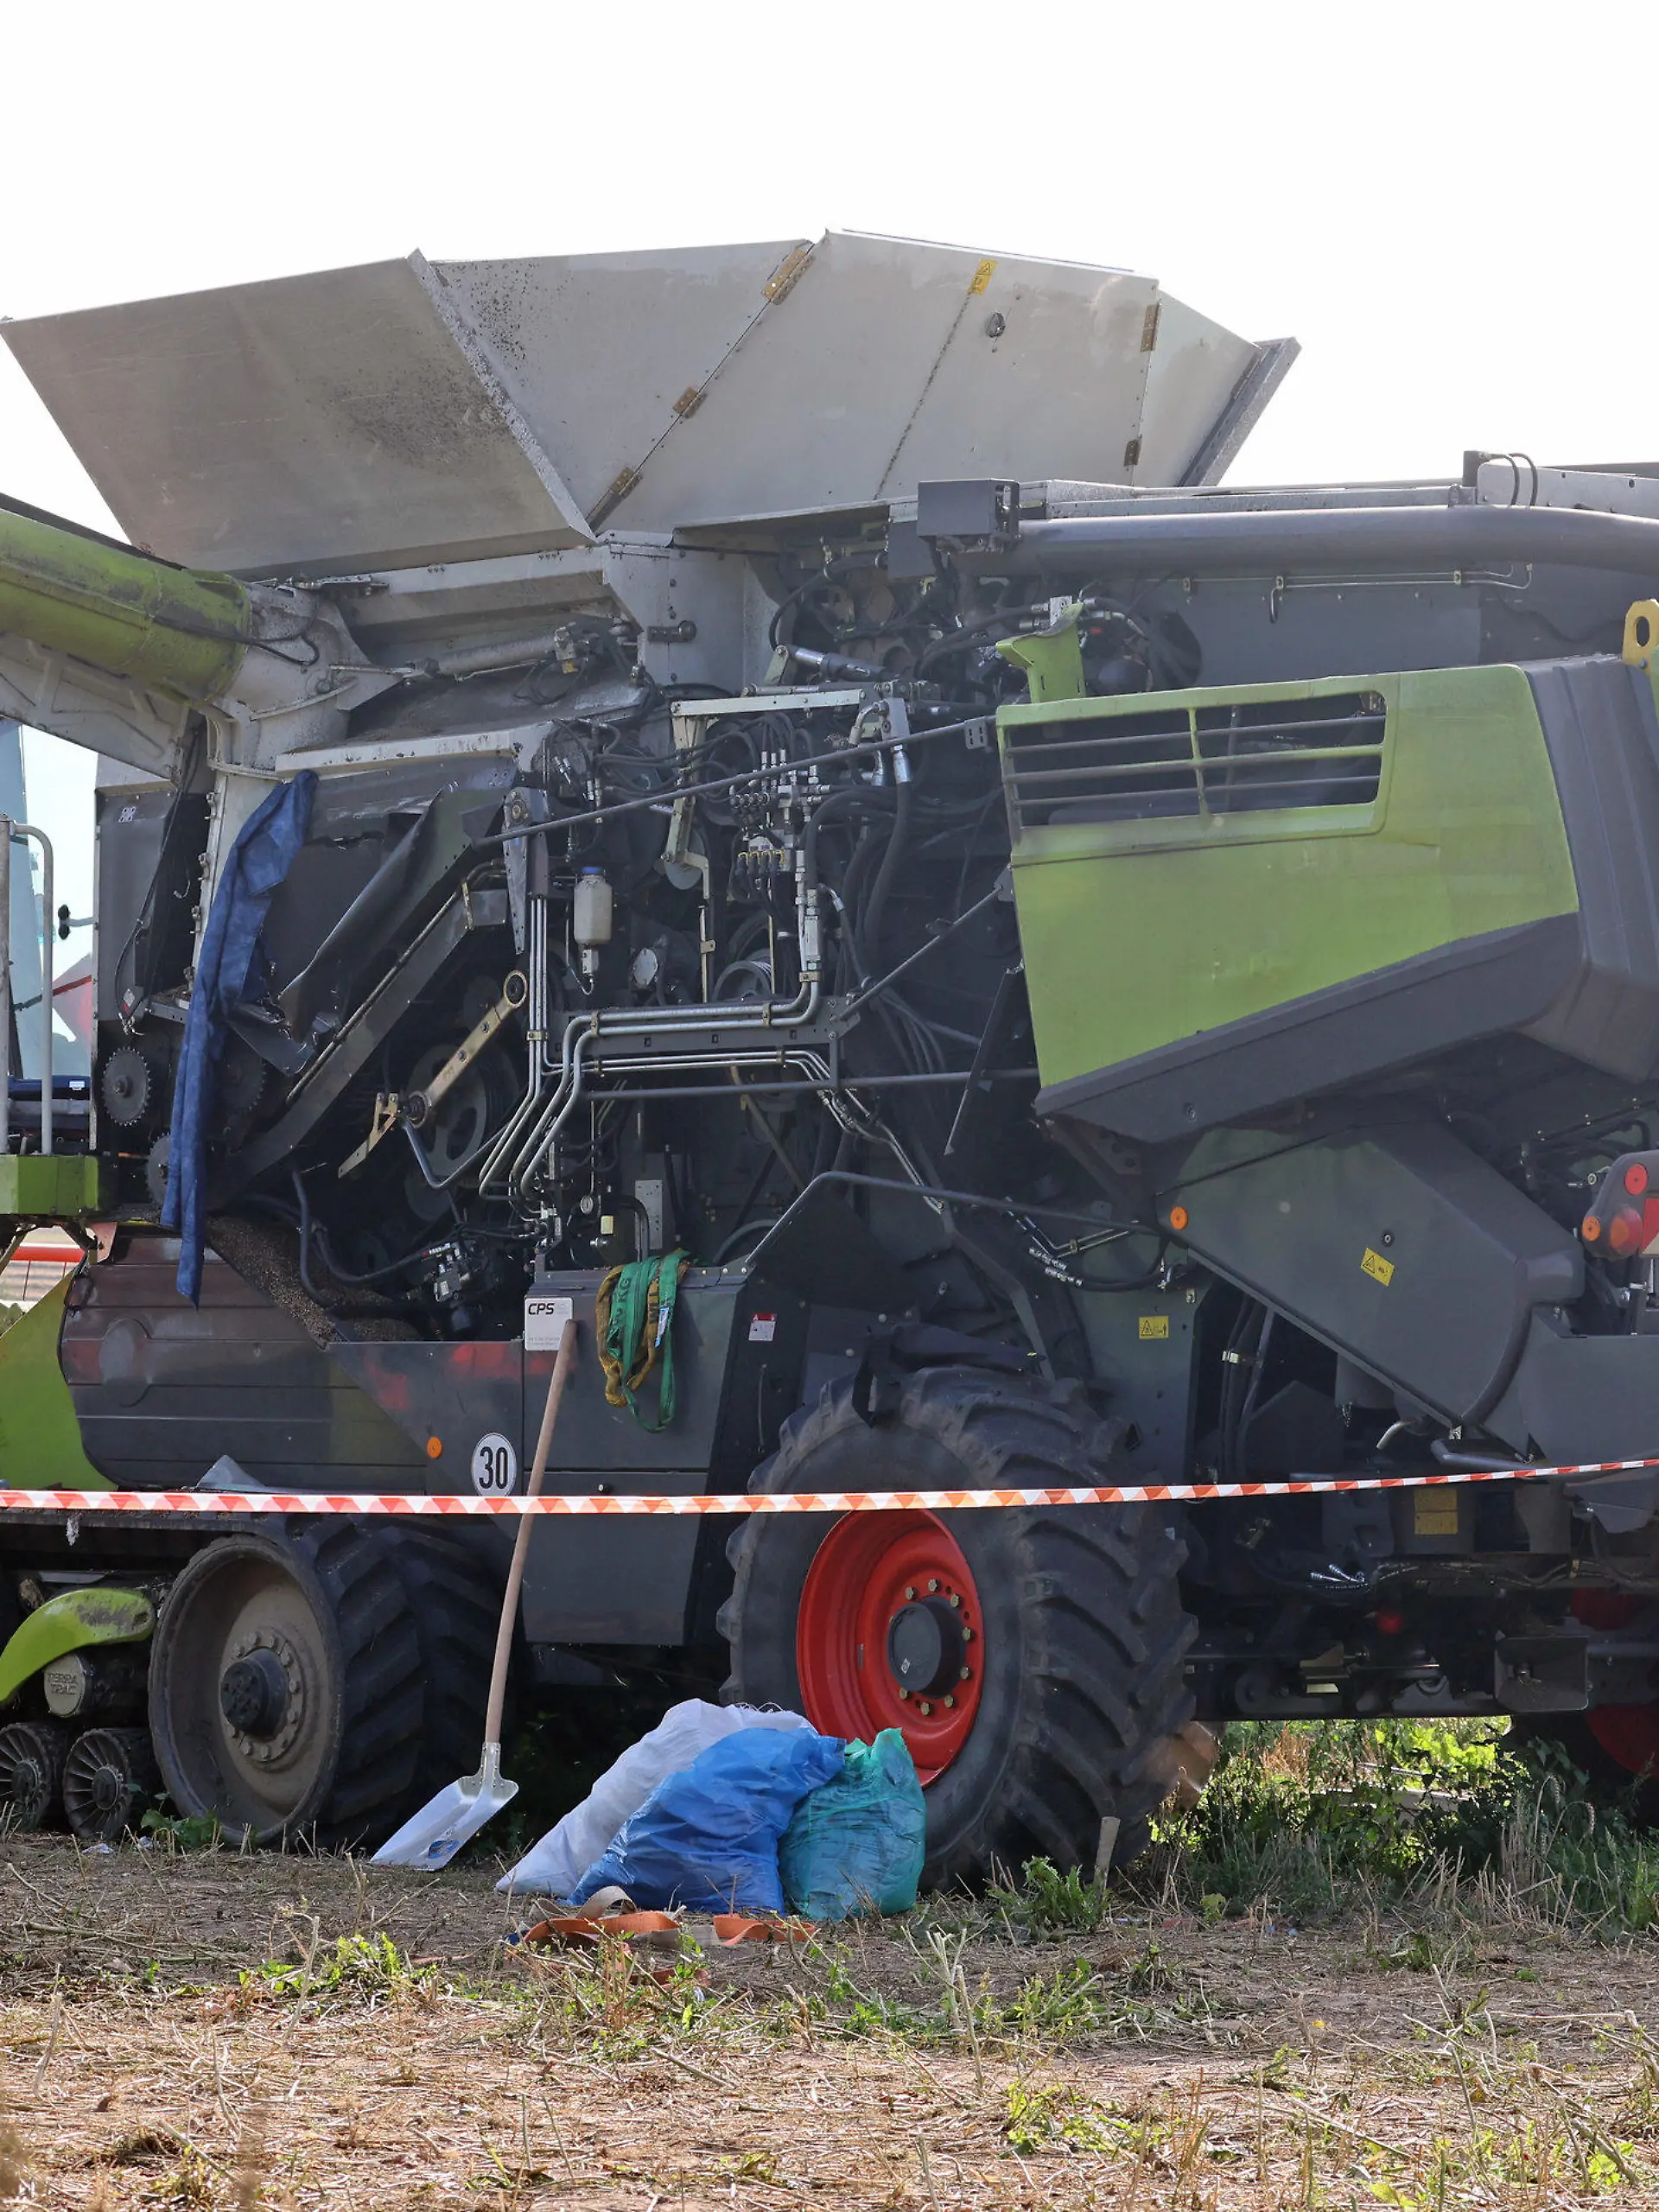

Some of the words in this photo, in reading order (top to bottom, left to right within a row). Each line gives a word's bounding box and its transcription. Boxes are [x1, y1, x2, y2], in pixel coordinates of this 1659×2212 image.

[616, 1277, 632, 1303] KG
[528, 1302, 555, 1315] CPS
[479, 1446, 509, 1490] 30
[50, 1683, 77, 1695] TRAC
